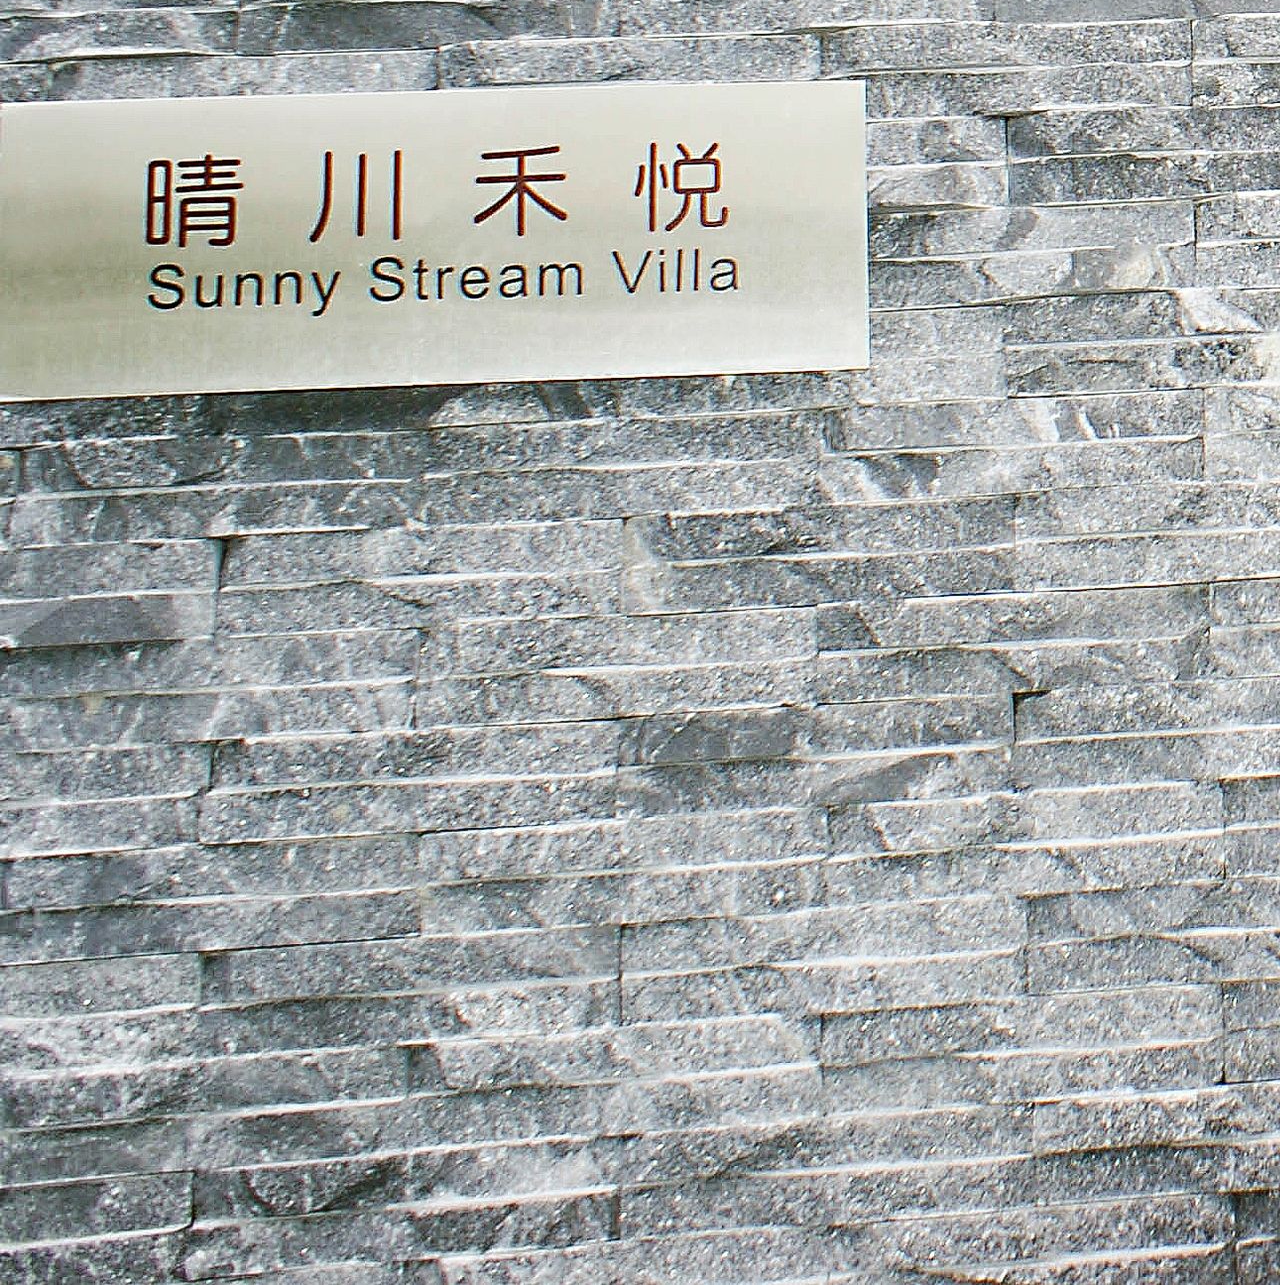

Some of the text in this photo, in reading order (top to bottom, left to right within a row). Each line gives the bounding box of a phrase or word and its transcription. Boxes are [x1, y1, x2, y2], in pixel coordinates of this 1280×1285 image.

[147, 248, 740, 317] Sunny Stream Villa
